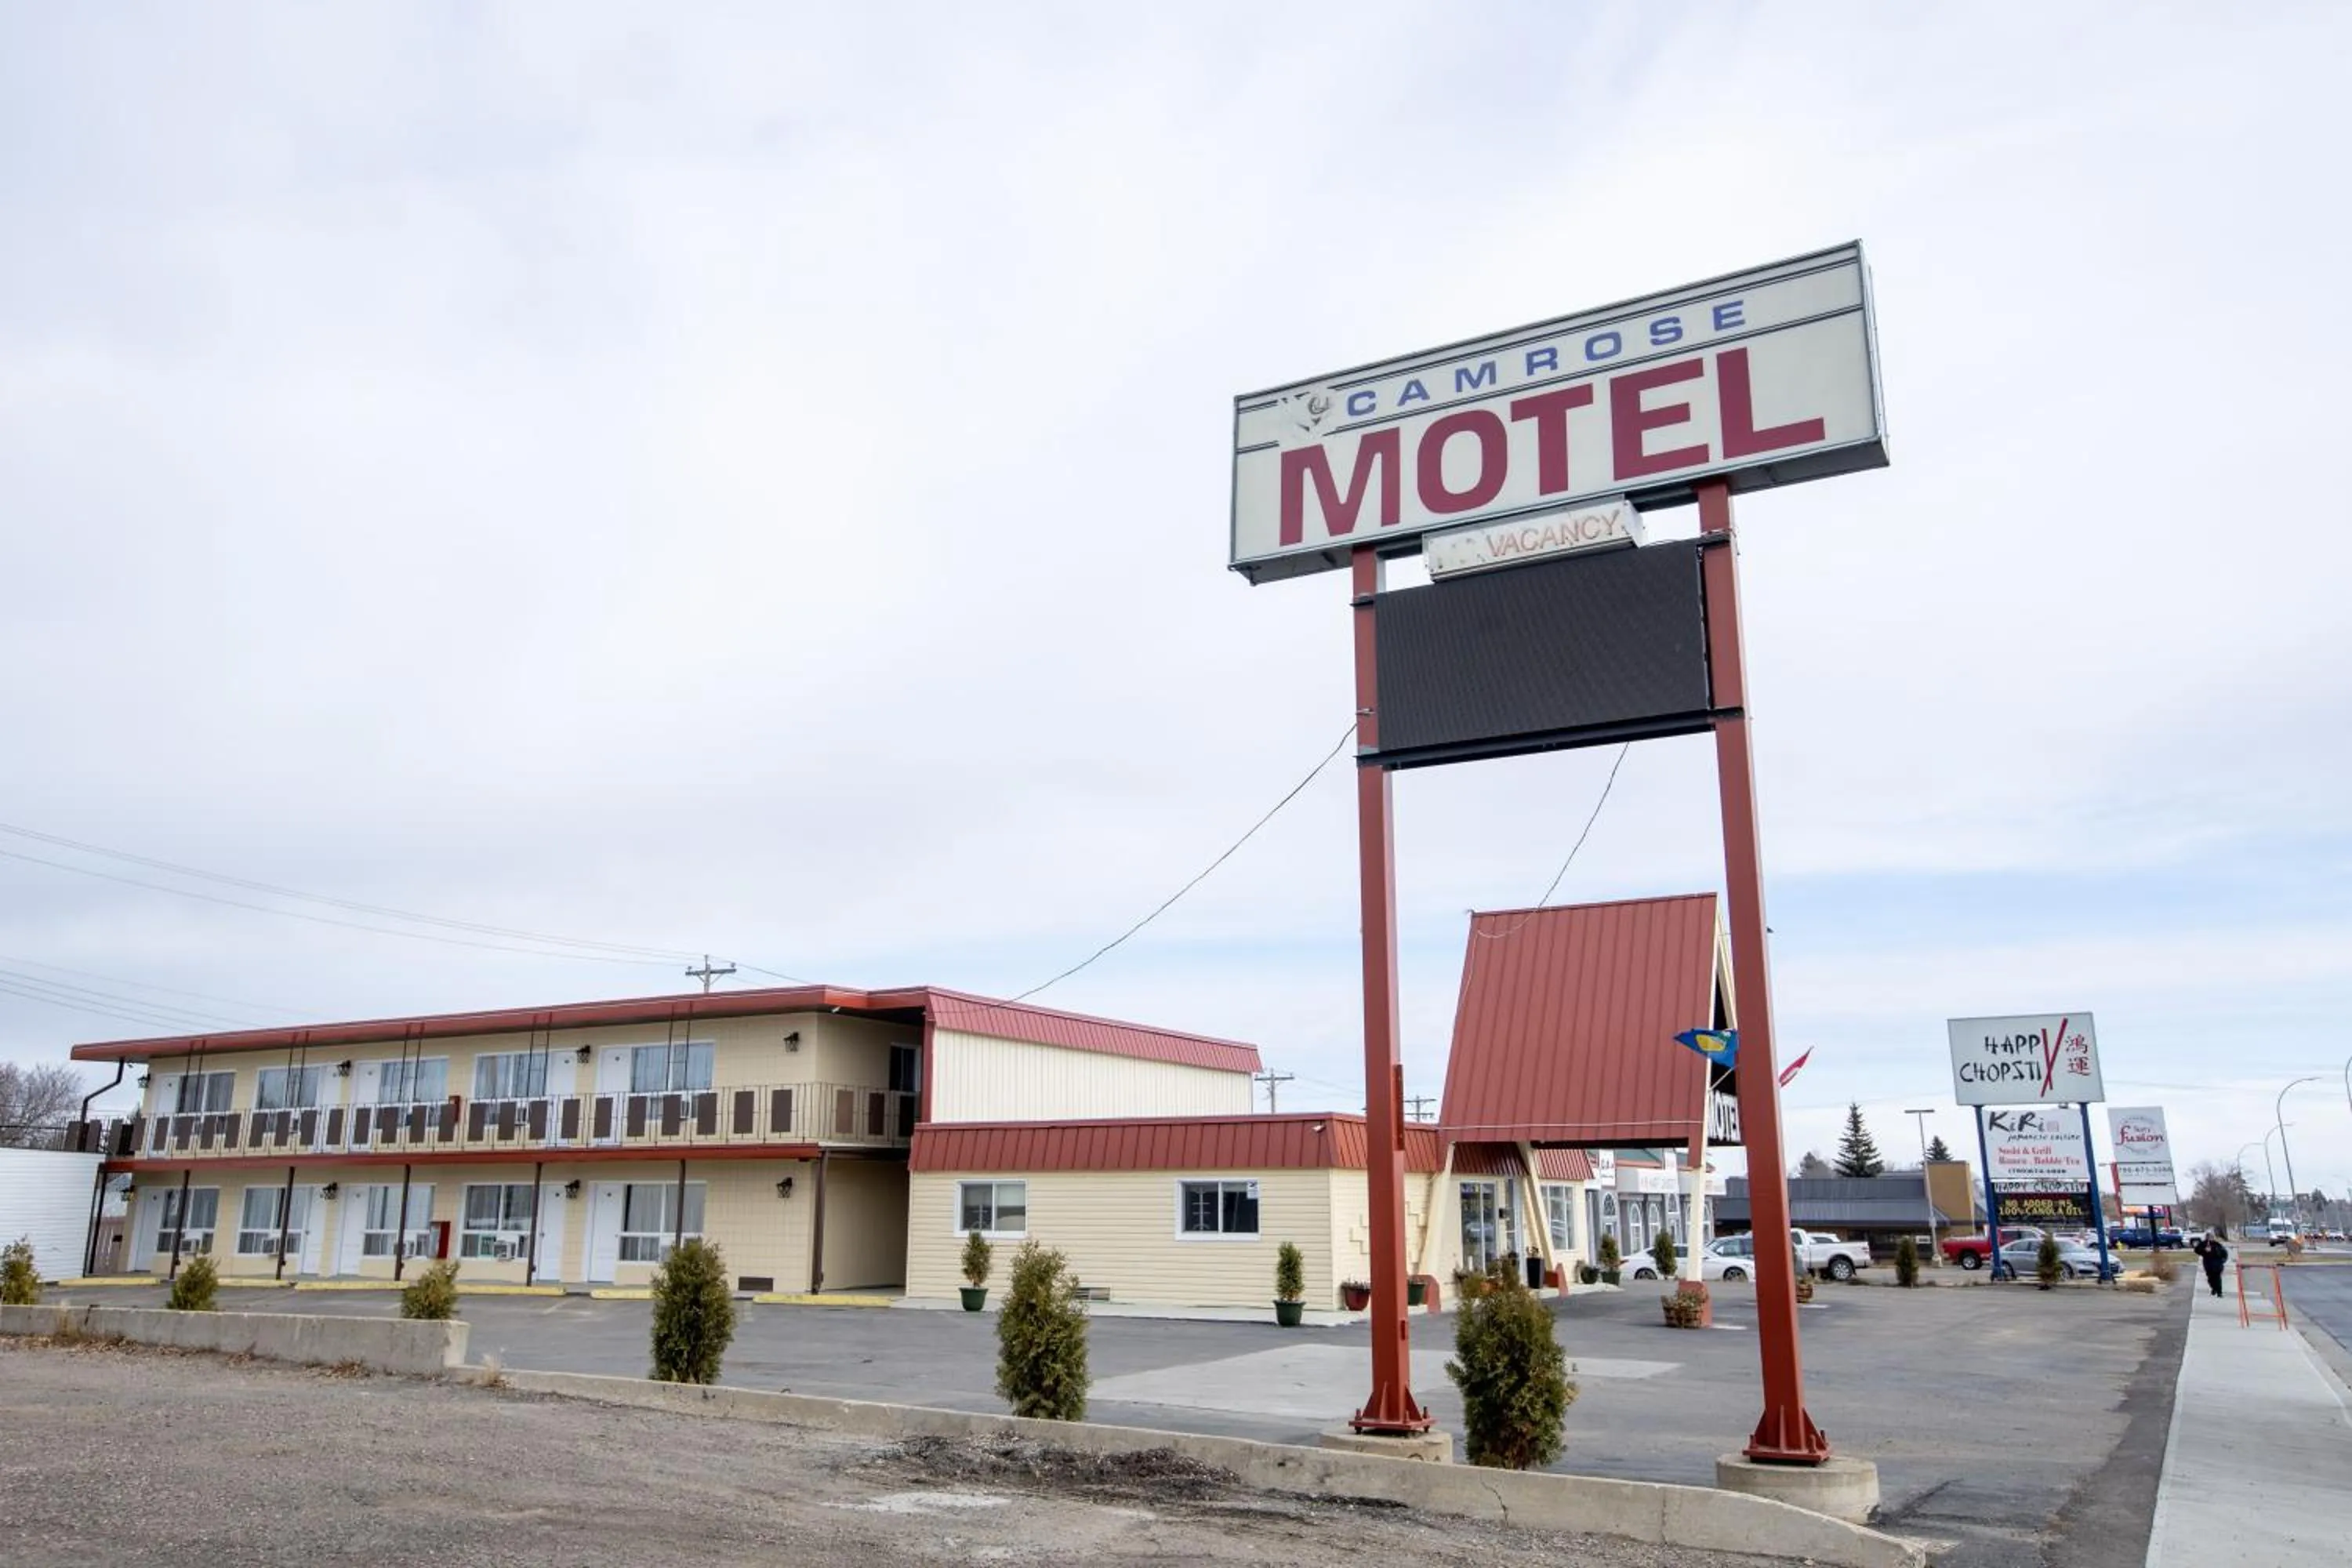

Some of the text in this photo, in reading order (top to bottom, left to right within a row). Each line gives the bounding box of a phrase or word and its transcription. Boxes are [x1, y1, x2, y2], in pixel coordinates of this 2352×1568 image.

[1346, 299, 1745, 416] CAMROSE
[1279, 347, 1825, 546] MOTEL
[1486, 509, 1620, 557] VACANCY
[2115, 1125, 2165, 1145] fusion
